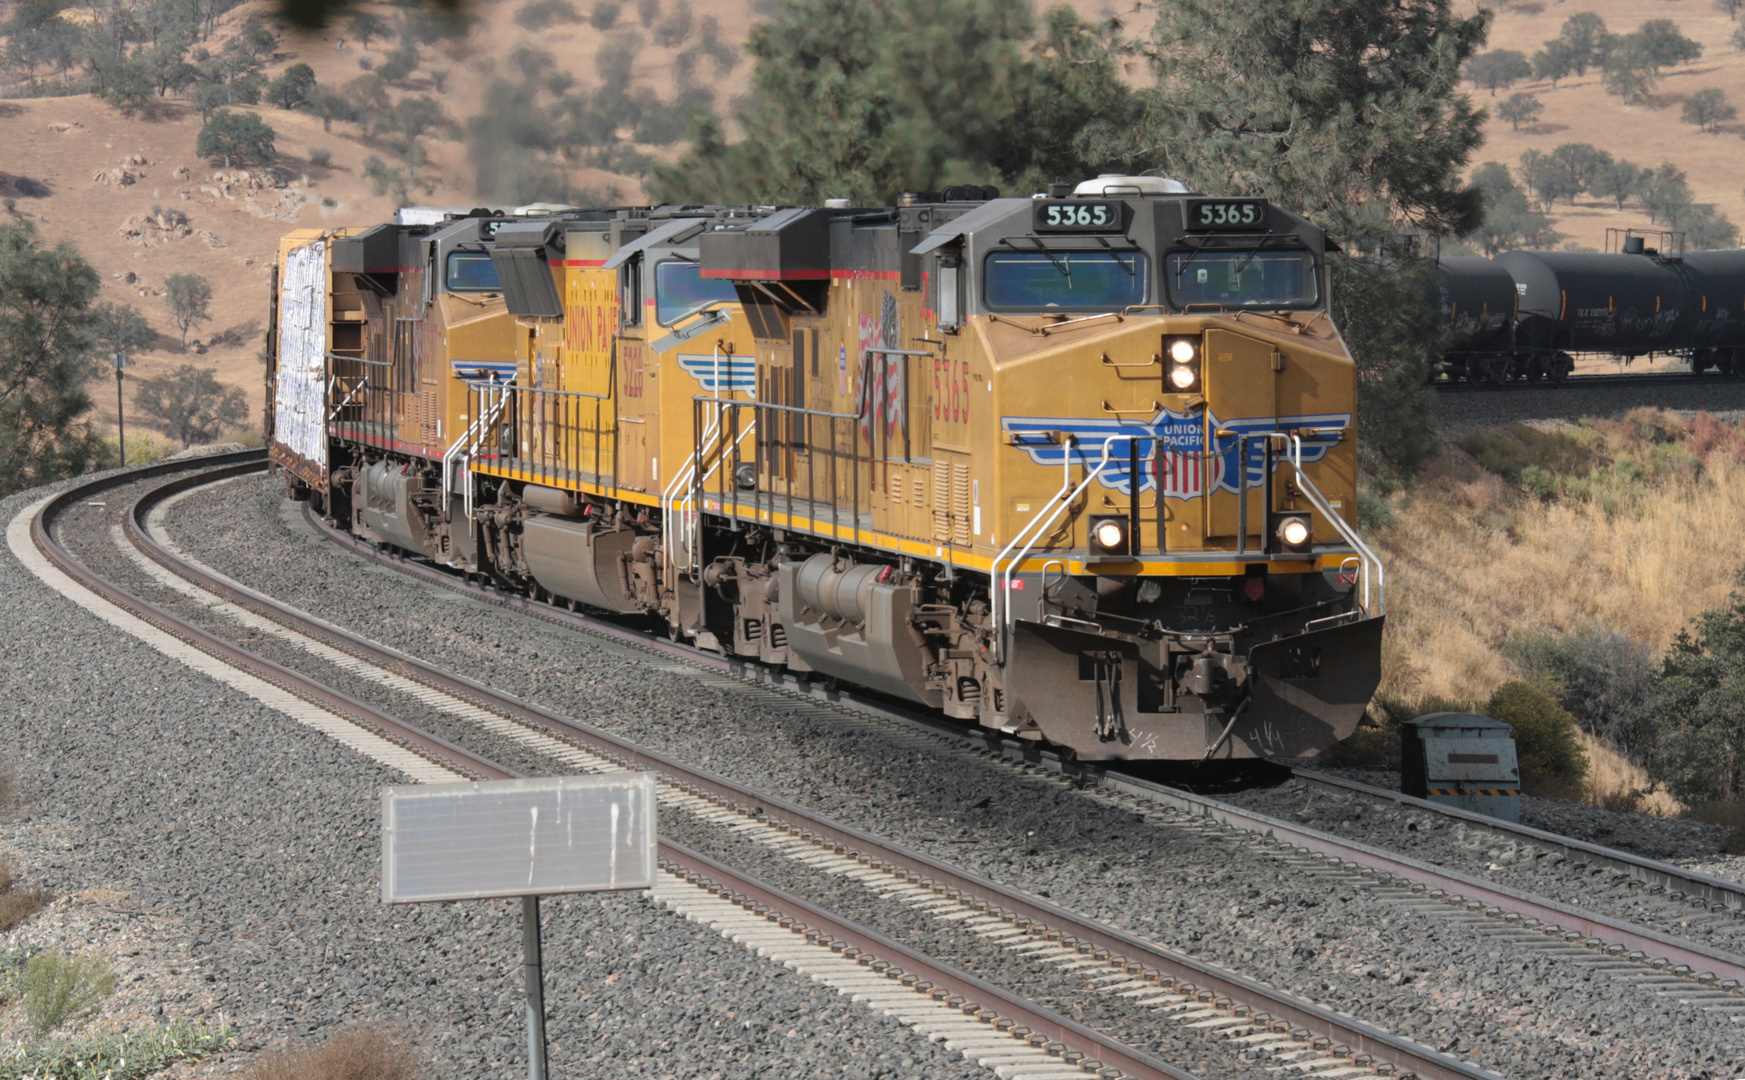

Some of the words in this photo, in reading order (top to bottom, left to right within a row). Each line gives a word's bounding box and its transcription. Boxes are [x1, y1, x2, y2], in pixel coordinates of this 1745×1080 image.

[1046, 205, 1107, 226] 5365
[1200, 204, 1255, 224] 5365
[934, 358, 969, 424] 5365
